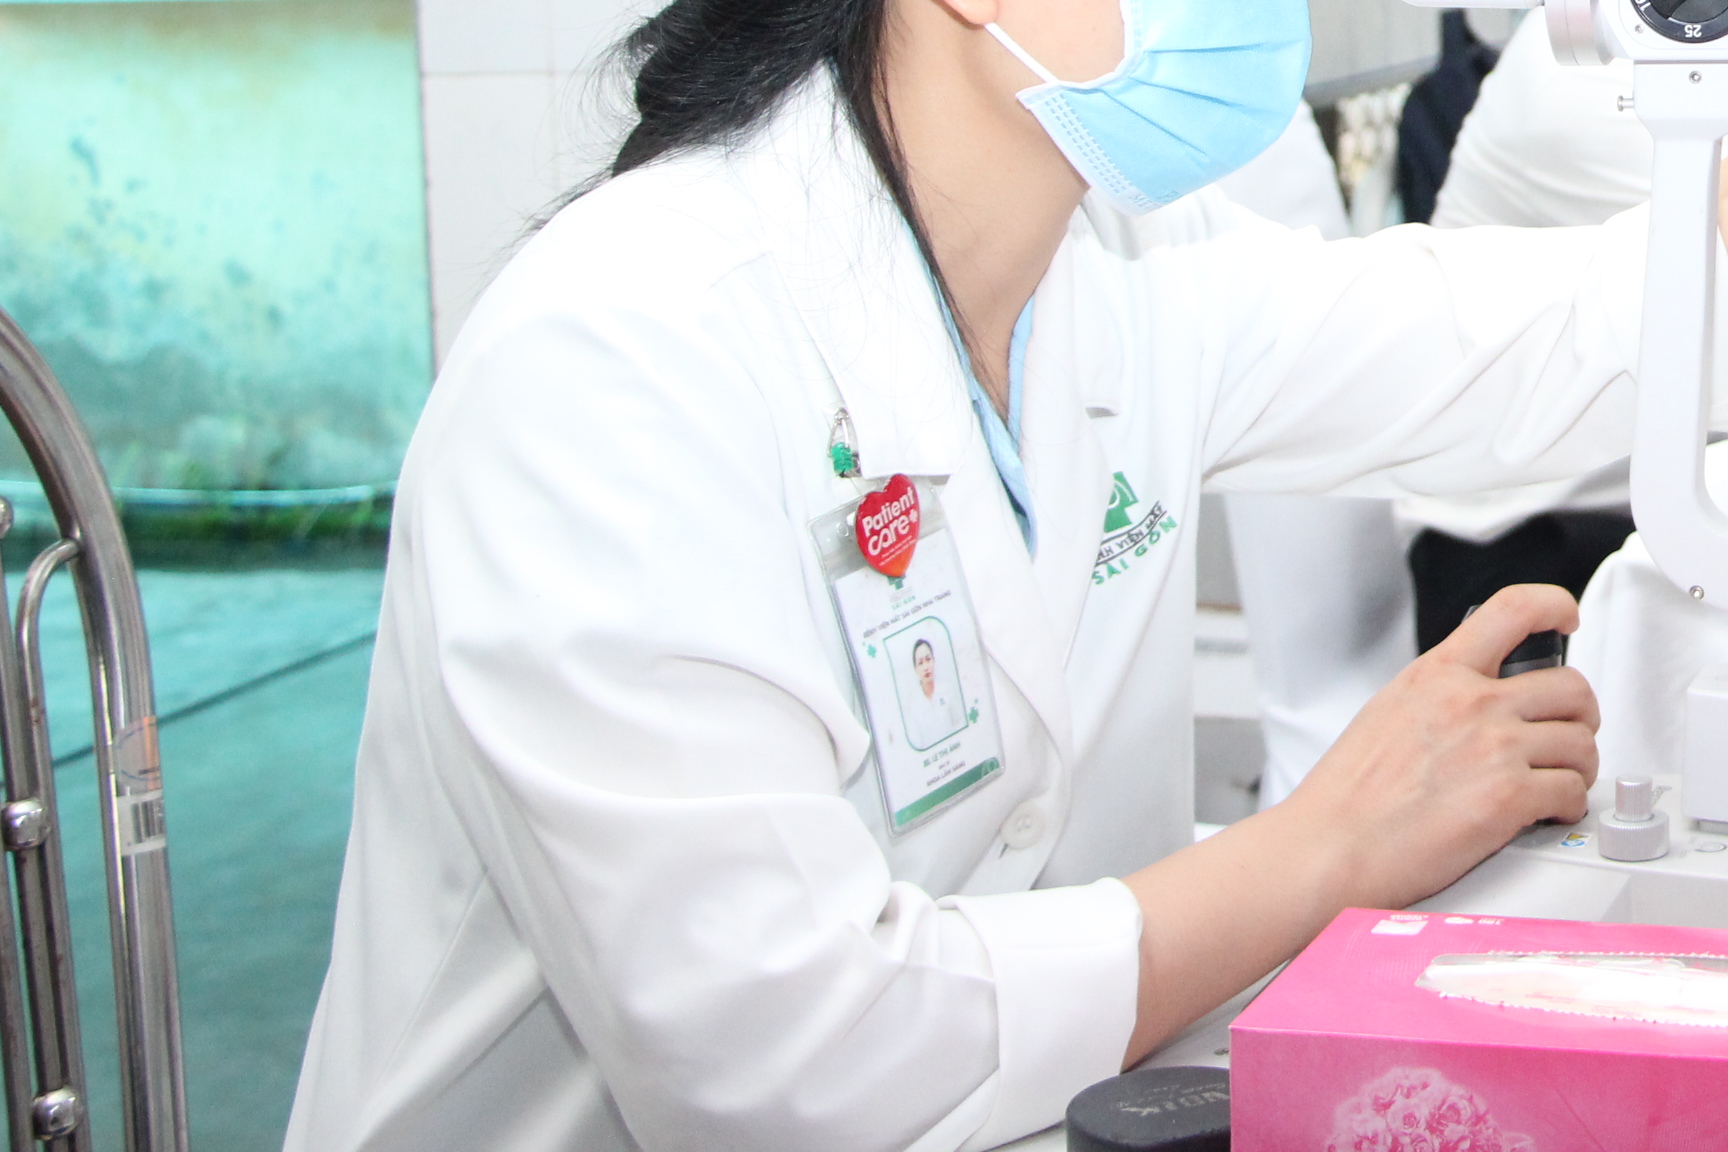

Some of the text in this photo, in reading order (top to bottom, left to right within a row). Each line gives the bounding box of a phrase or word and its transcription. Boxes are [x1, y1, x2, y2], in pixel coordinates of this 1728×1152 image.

[1683, 24, 1702, 38] 25
[861, 486, 915, 538] Patient
[867, 514, 911, 556] care
